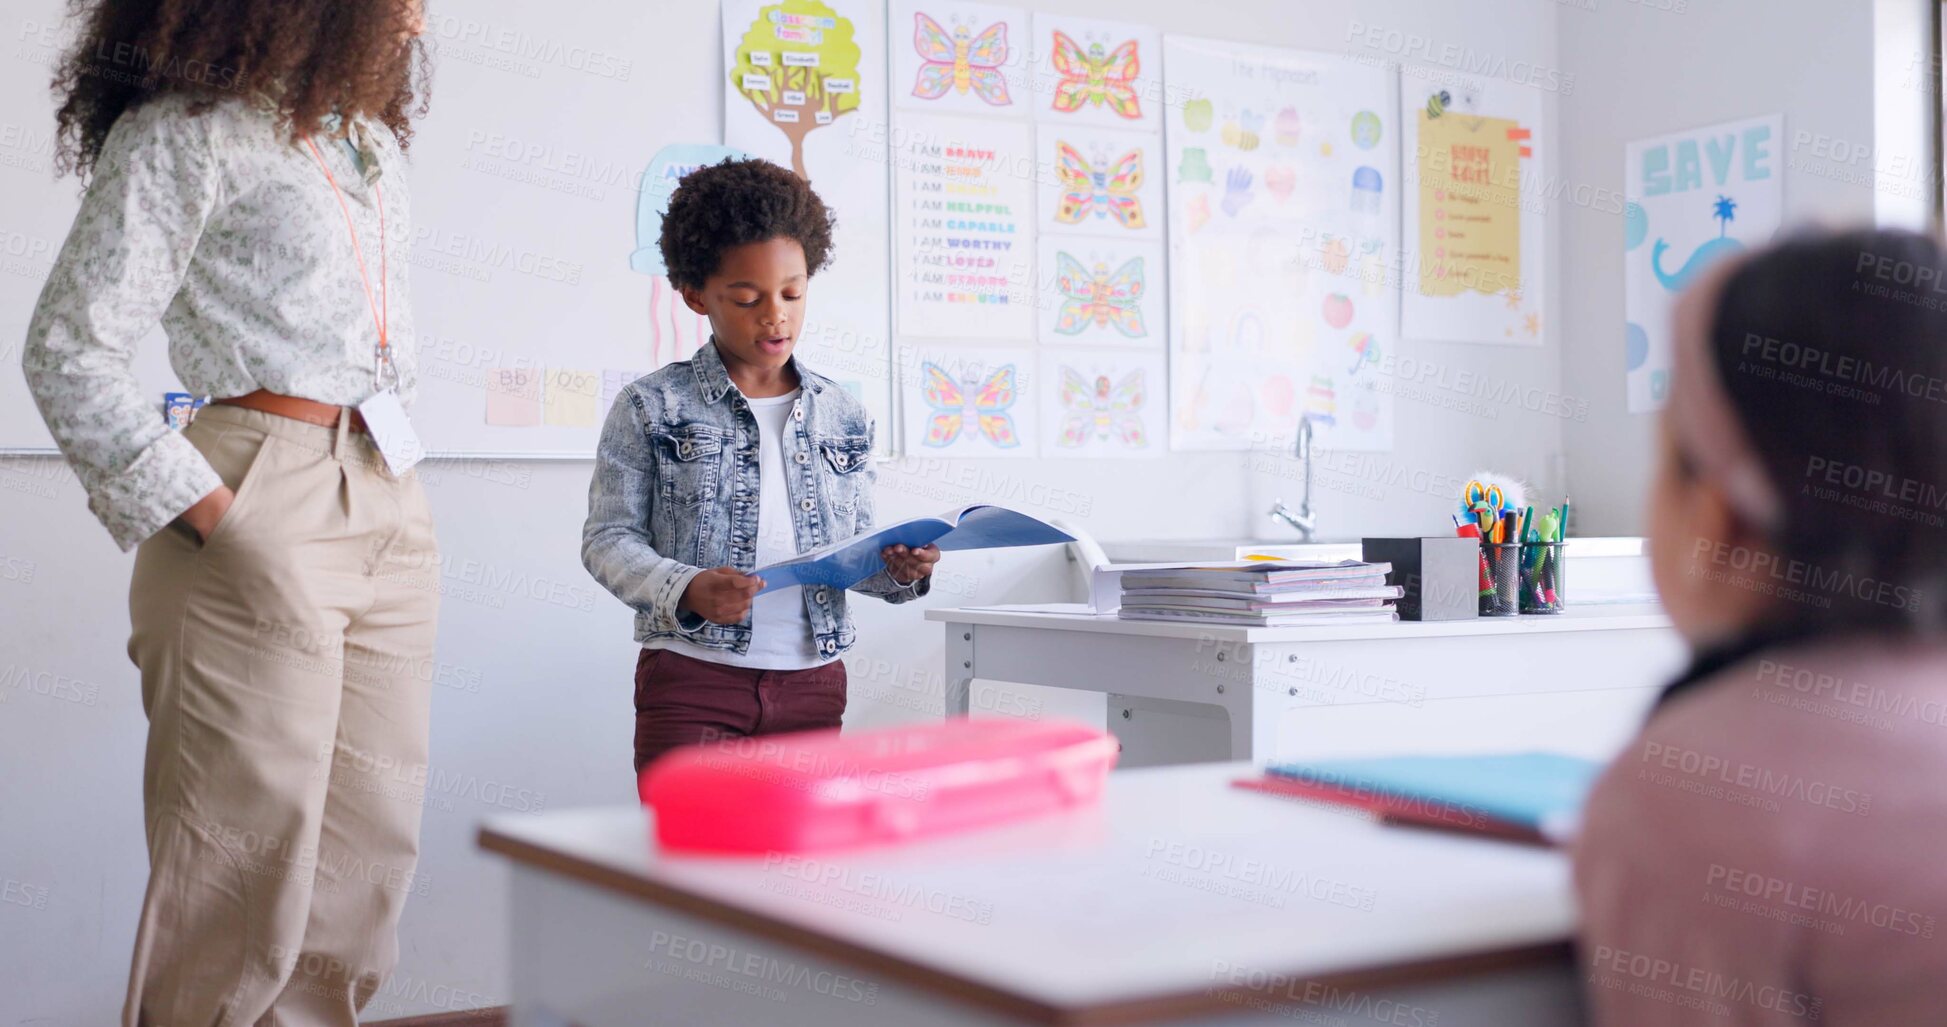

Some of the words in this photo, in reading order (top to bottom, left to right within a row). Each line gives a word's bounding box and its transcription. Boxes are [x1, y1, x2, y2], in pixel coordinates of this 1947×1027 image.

[920, 145, 941, 156] AM
[946, 147, 995, 160] BRAVE
[1643, 125, 1771, 197] SAVE
[921, 163, 941, 174] AM
[921, 182, 941, 192] AM
[921, 200, 942, 211] AM
[946, 201, 1012, 215] HELPFUL
[921, 219, 942, 229] AM
[946, 220, 1016, 233] CAPABLE
[921, 237, 942, 247] AM
[946, 238, 1012, 251] WORTHY
[921, 255, 942, 265] AM
[922, 272, 943, 283] AM
[922, 291, 943, 302] AM
